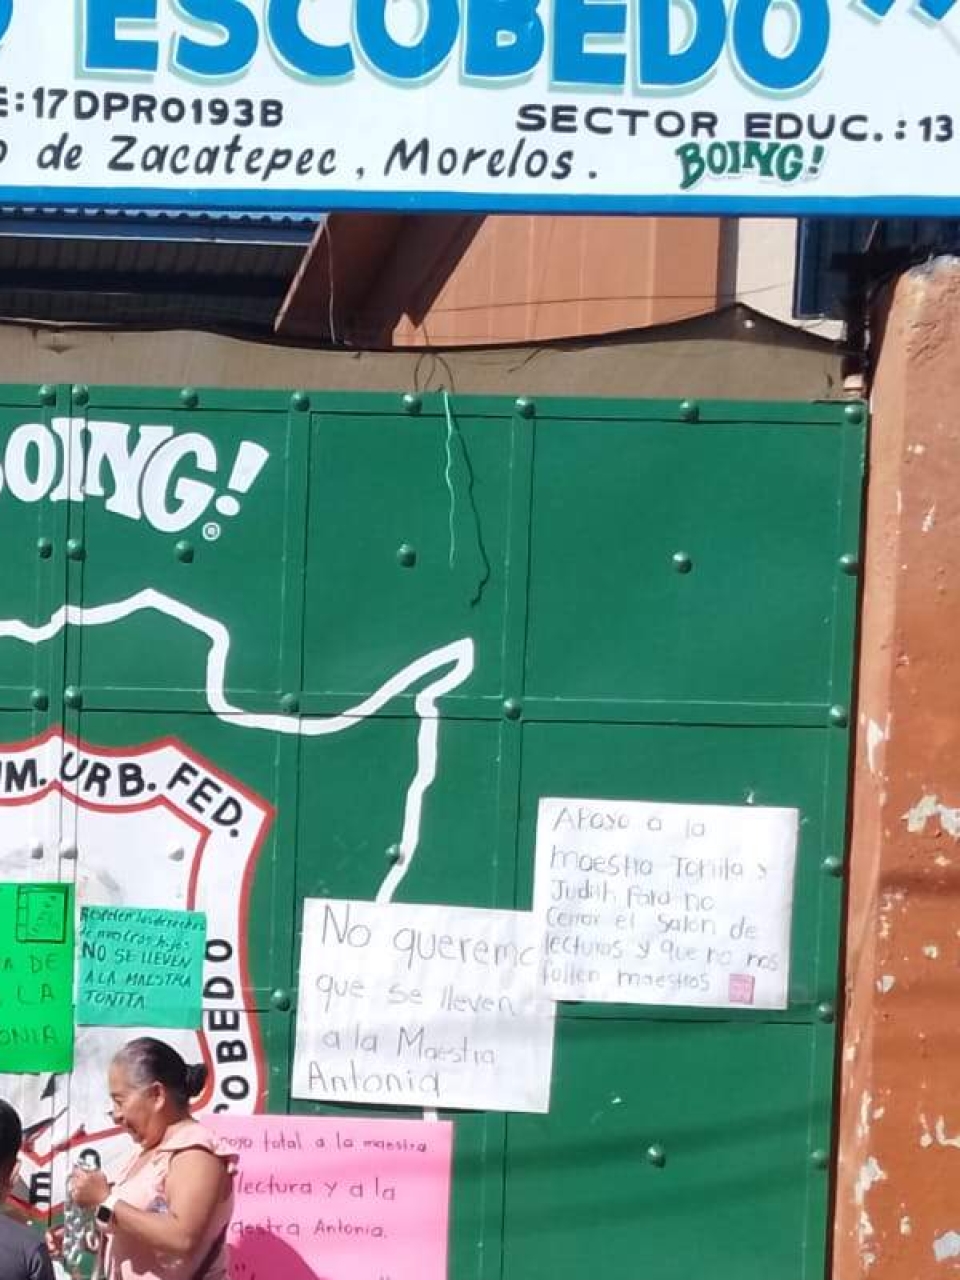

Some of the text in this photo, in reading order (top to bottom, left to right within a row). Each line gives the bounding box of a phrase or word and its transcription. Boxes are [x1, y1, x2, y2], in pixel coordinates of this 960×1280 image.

[516, 104, 719, 139] SECTOR
[36, 132, 82, 171] de
[674, 140, 825, 190] BOING!
[58, 752, 156, 798] URB.
[166, 762, 244, 838] FED.
[647, 816, 662, 831] a
[685, 818, 705, 839] la
[322, 903, 371, 948] No
[616, 912, 635, 932] el
[729, 915, 756, 940] de
[30, 953, 59, 974] DE
[82, 940, 106, 962] NO
[115, 948, 135, 964] SE
[638, 940, 651, 960] y
[660, 938, 699, 964] que
[17, 983, 54, 1007] LA
[315, 973, 364, 1013] que
[440, 985, 515, 1016] lleven
[322, 1024, 496, 1064] a la Maestra
[308, 1059, 441, 1098] Antonia
[264, 1129, 301, 1152] total
[315, 1137, 325, 1149] a
[336, 1131, 354, 1149] la
[363, 1138, 427, 1153] maestra
[237, 1170, 313, 1195] lectura
[349, 1183, 364, 1198] a
[376, 1177, 395, 1201] la
[230, 1217, 300, 1239] aestra
